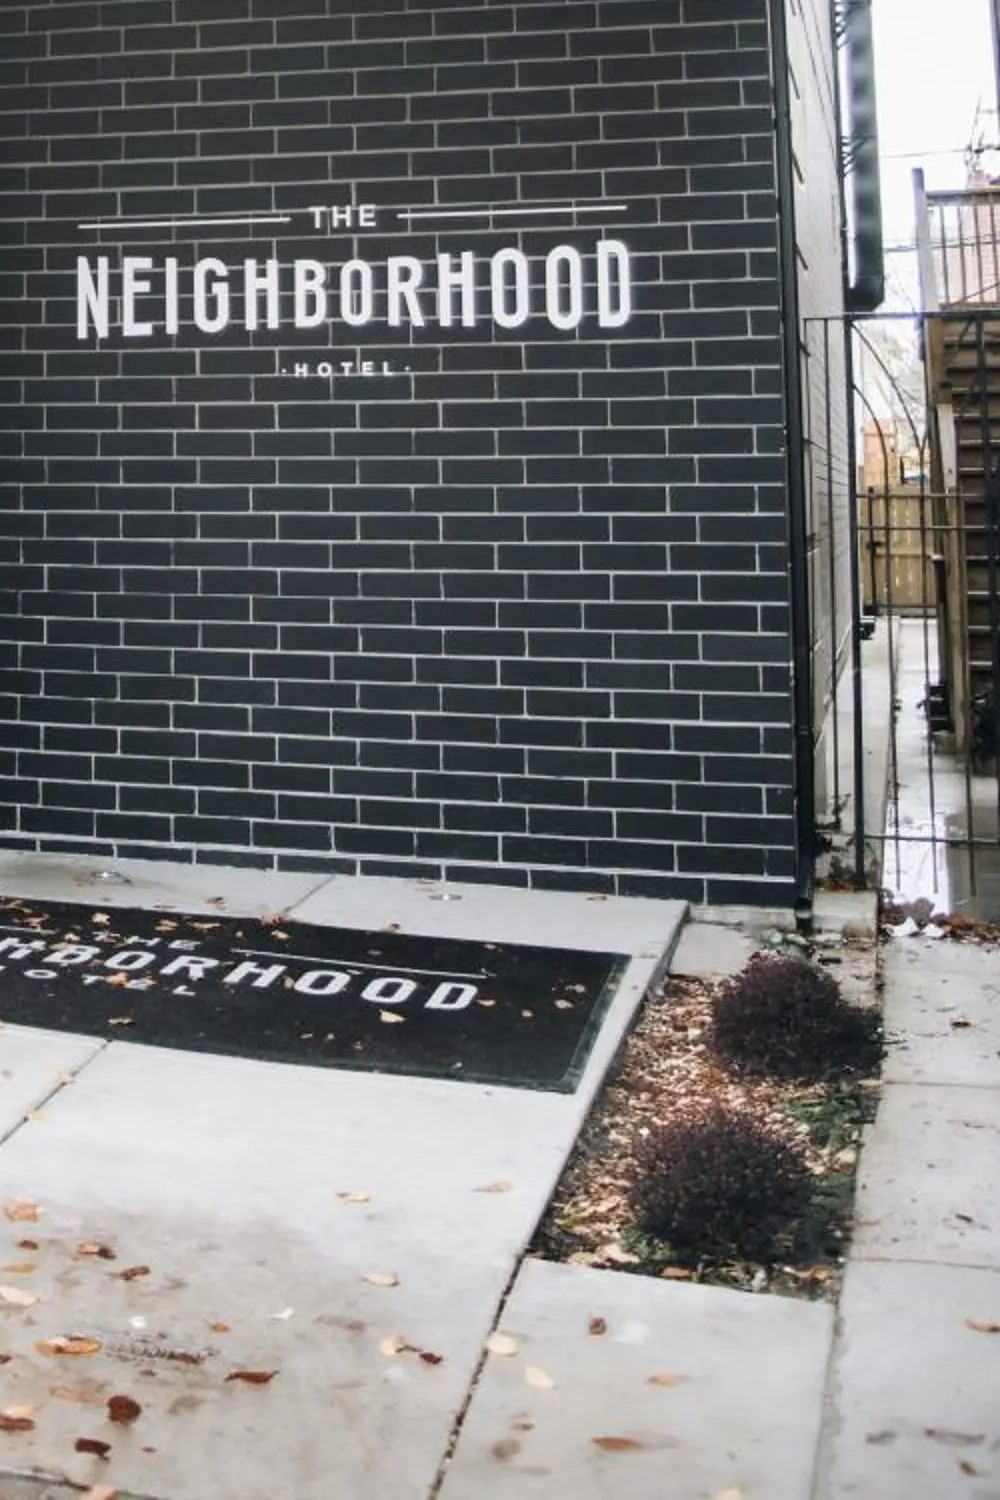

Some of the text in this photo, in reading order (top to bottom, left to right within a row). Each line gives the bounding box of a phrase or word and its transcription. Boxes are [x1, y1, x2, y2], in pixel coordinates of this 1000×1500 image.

[308, 204, 377, 229] THE
[76, 240, 631, 340] NEIGHBORHOOD
[294, 361, 394, 378] HOTEL
